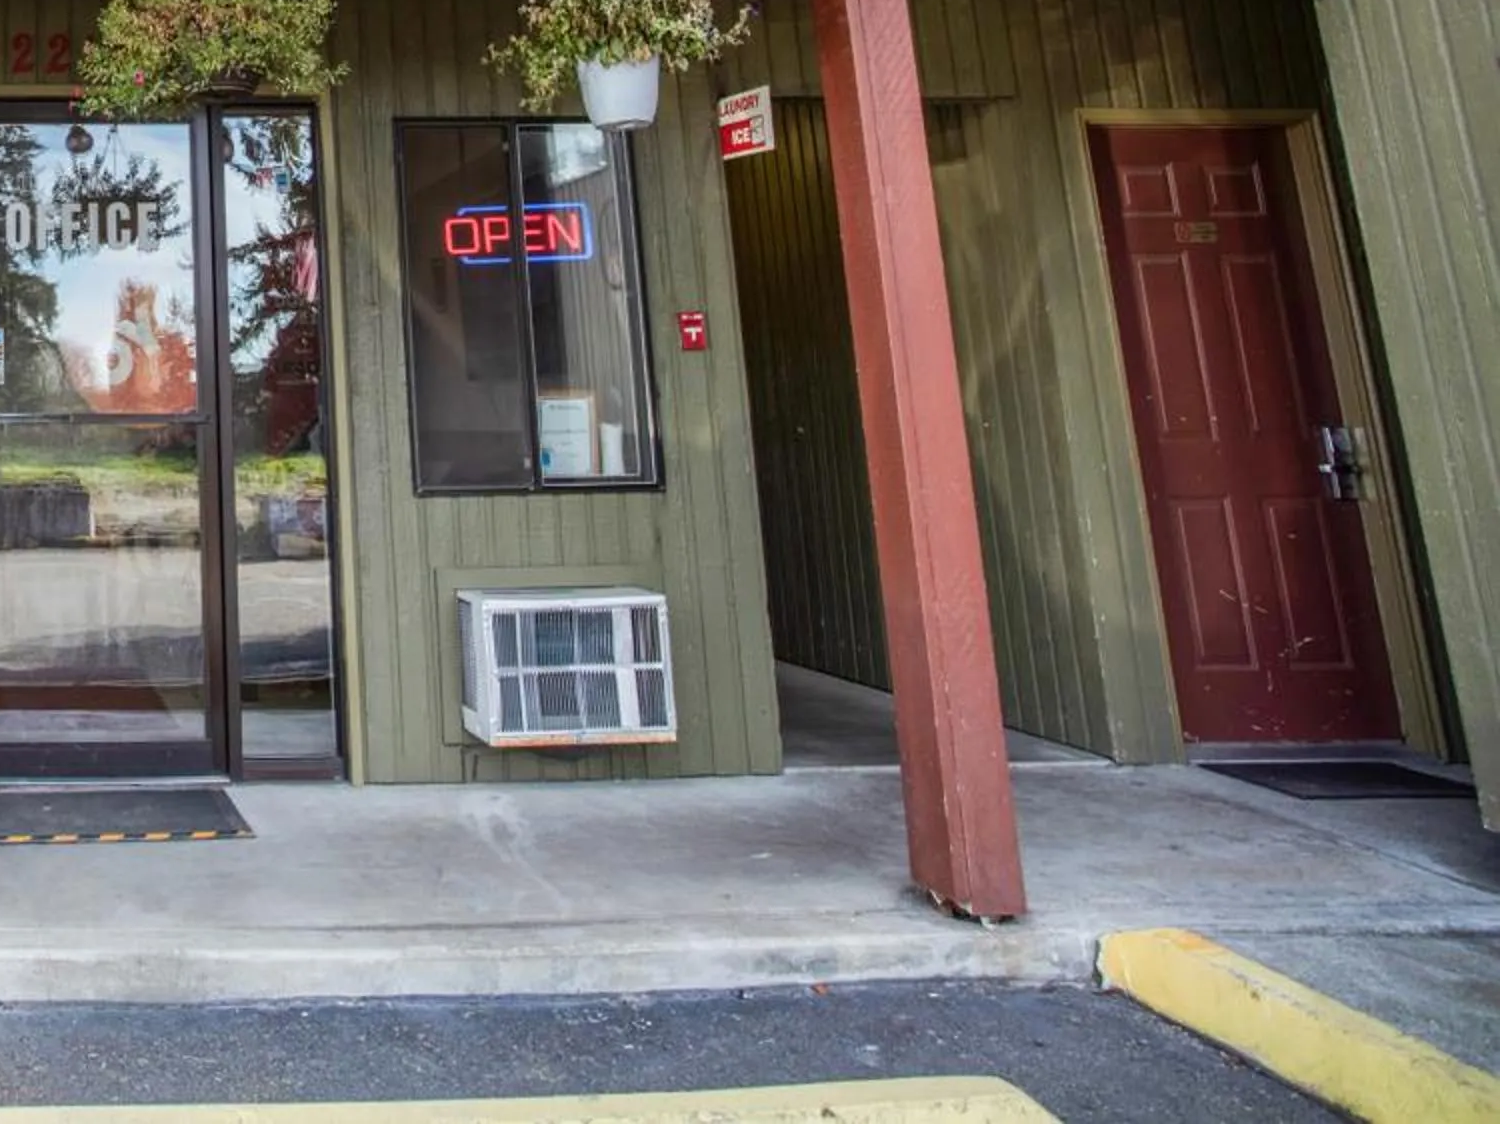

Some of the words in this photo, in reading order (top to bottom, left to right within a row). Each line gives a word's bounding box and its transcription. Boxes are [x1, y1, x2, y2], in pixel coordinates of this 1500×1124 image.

[716, 94, 760, 118] LAUNDRY
[731, 127, 751, 147] ICE
[5, 201, 160, 252] OFFICE
[445, 211, 583, 255] OPEN
